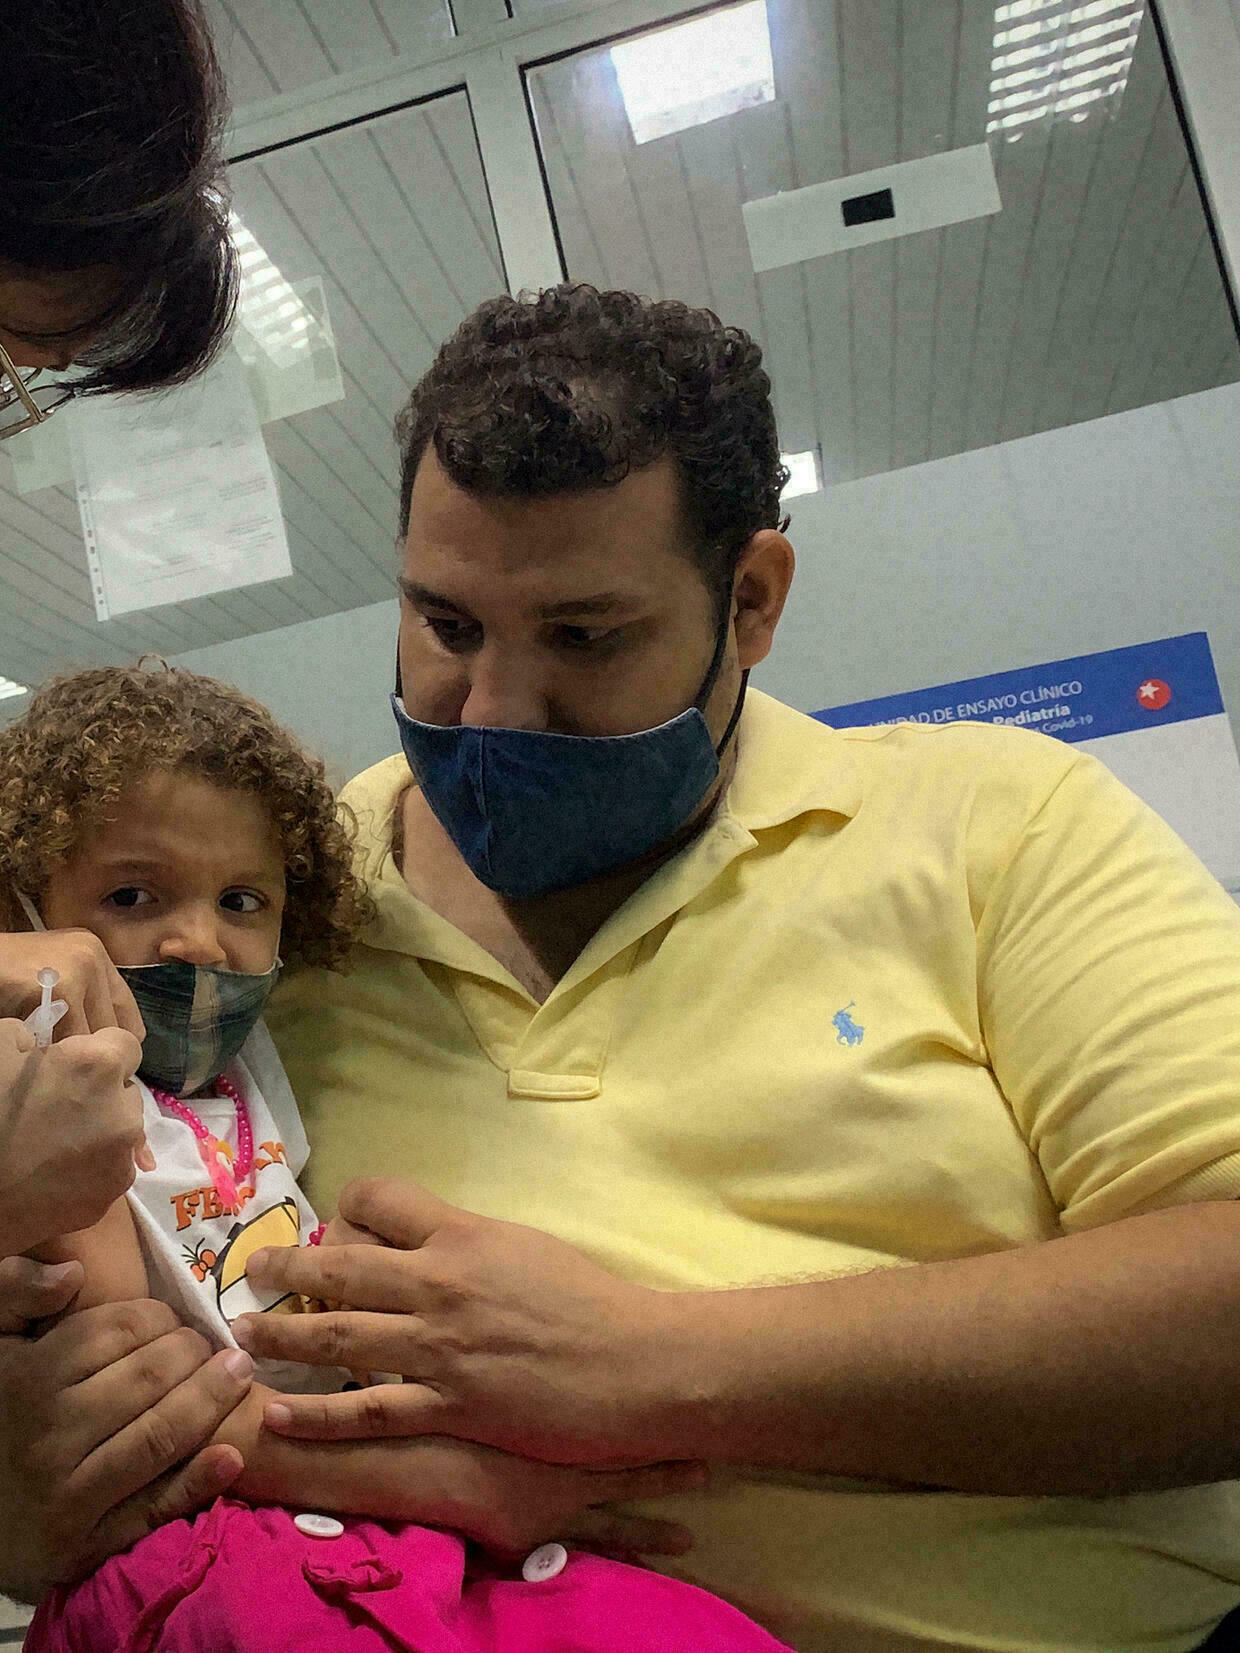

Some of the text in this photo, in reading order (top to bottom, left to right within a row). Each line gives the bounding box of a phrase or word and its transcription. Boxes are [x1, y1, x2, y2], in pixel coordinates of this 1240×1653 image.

[869, 680, 1083, 726] DAD DE ENSAYO CLÍNICO
[993, 703, 1071, 727] Pediatría
[1042, 714, 1094, 733] Covid-19
